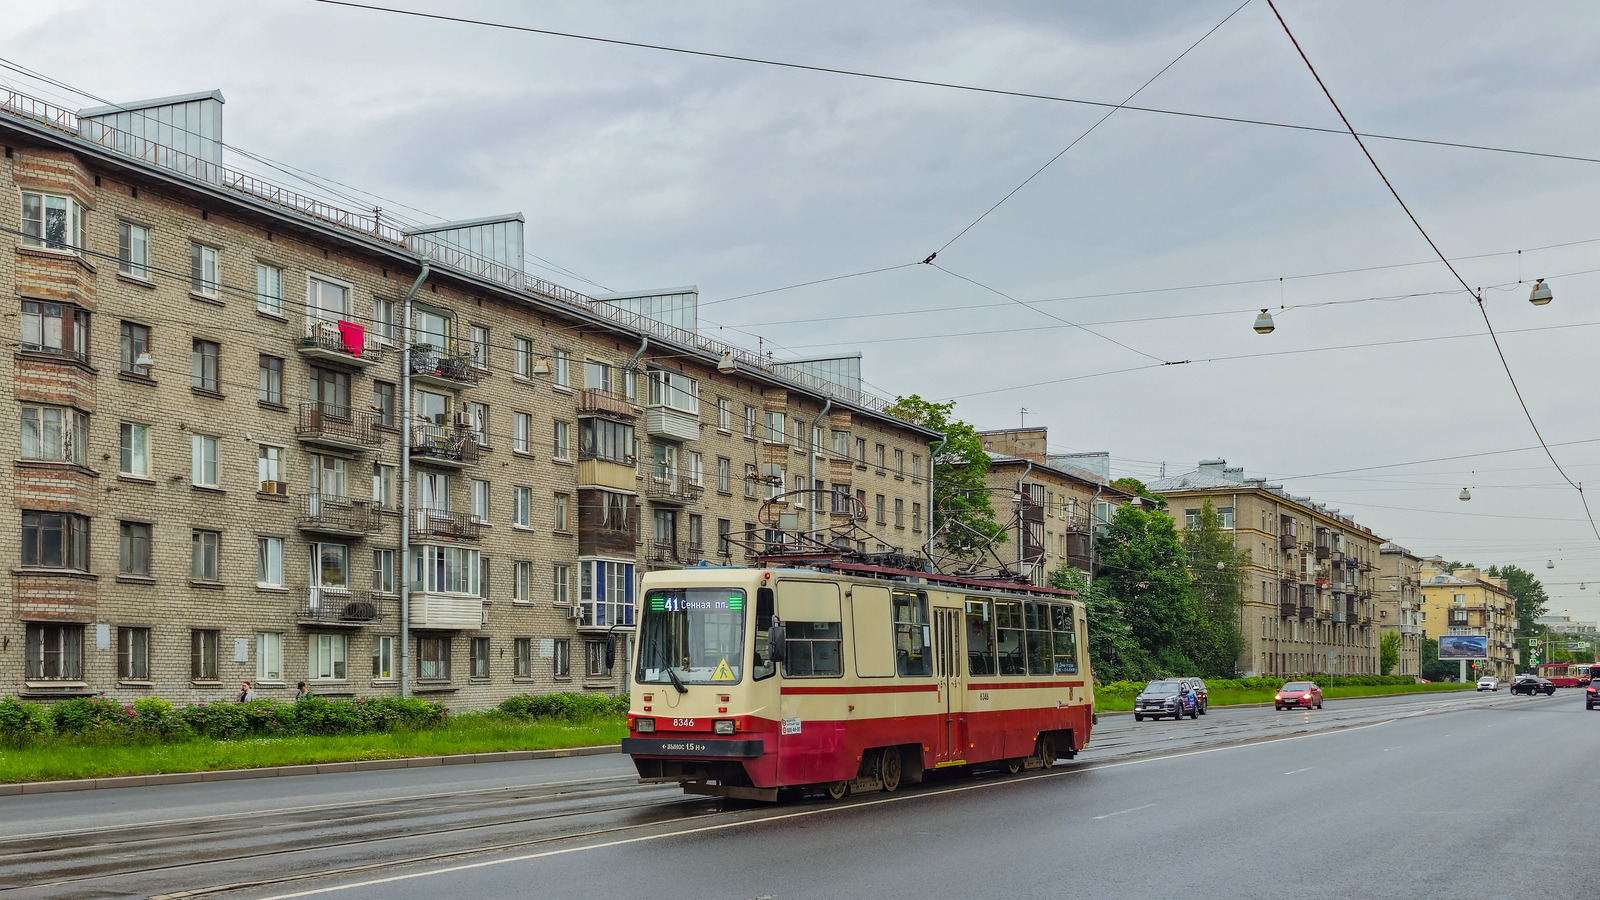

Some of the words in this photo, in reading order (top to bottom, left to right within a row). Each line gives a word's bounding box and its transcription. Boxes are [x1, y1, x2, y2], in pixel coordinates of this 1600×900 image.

[664, 597, 680, 612] 41
[681, 599, 711, 609] Сенная
[715, 601, 728, 609] пл.
[673, 718, 695, 727] 8346
